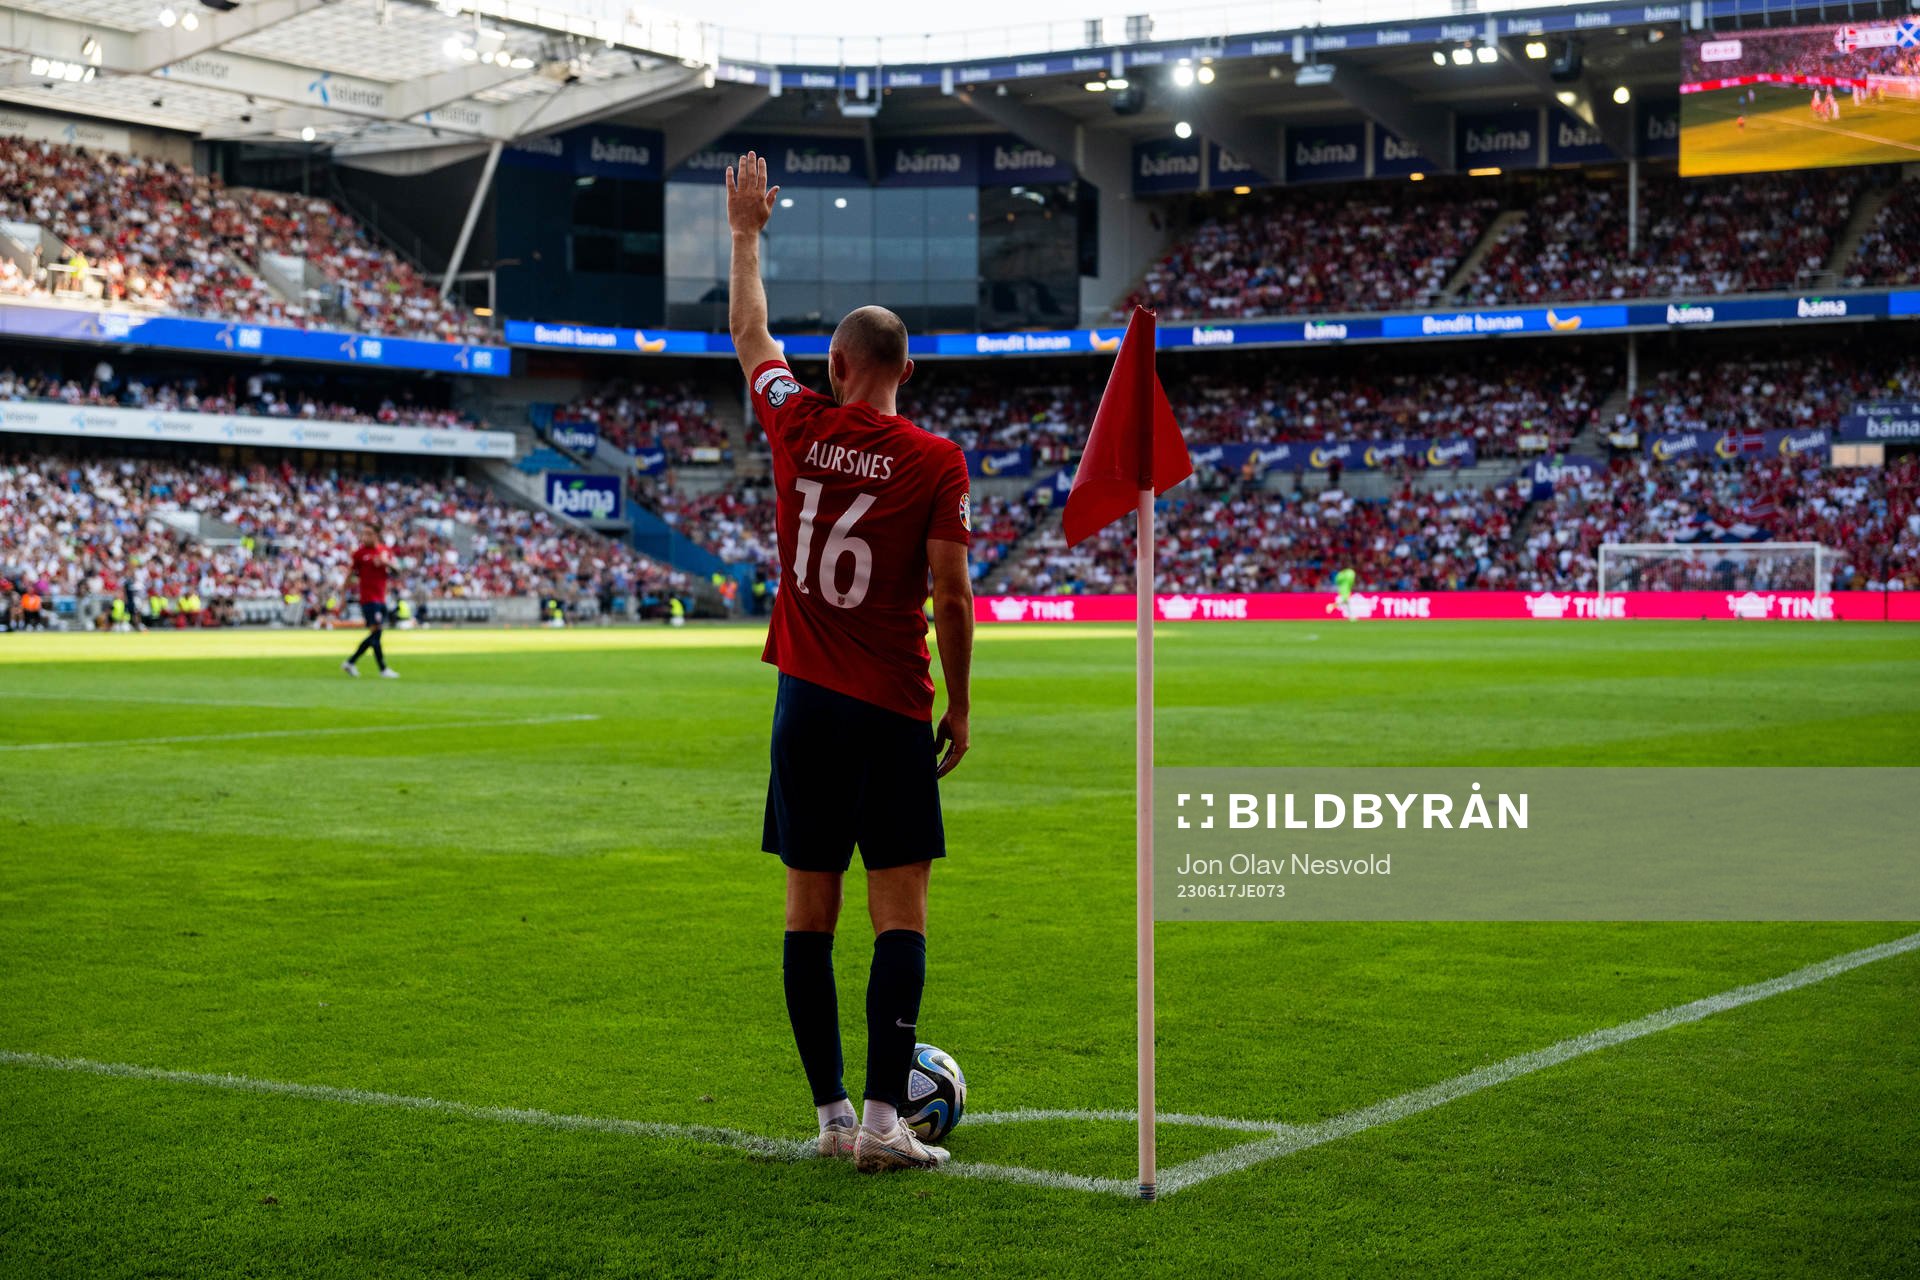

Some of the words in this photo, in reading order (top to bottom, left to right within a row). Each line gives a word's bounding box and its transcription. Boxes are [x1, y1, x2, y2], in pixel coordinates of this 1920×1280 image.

[1467, 128, 1530, 153] bama
[785, 148, 850, 173] bama
[896, 150, 960, 173] bama
[1296, 142, 1356, 165] bama
[1141, 153, 1199, 176] bama
[1666, 304, 1714, 323] bama
[1798, 298, 1847, 317] bama
[1304, 321, 1347, 340] bama
[1422, 315, 1473, 334] Bendit
[1475, 313, 1523, 331] banan
[976, 335, 1025, 352] Bendit
[1025, 334, 1070, 350] banan
[1192, 326, 1234, 344] bama
[1866, 417, 1920, 438] bama
[805, 441, 894, 480] AURSNES
[553, 479, 616, 513] bama
[793, 477, 878, 609] 16
[1031, 600, 1075, 620] TINE
[1200, 599, 1248, 619] TINE
[1380, 597, 1431, 618] TINE
[1572, 597, 1626, 618] TINE
[1777, 597, 1835, 619] TINE
